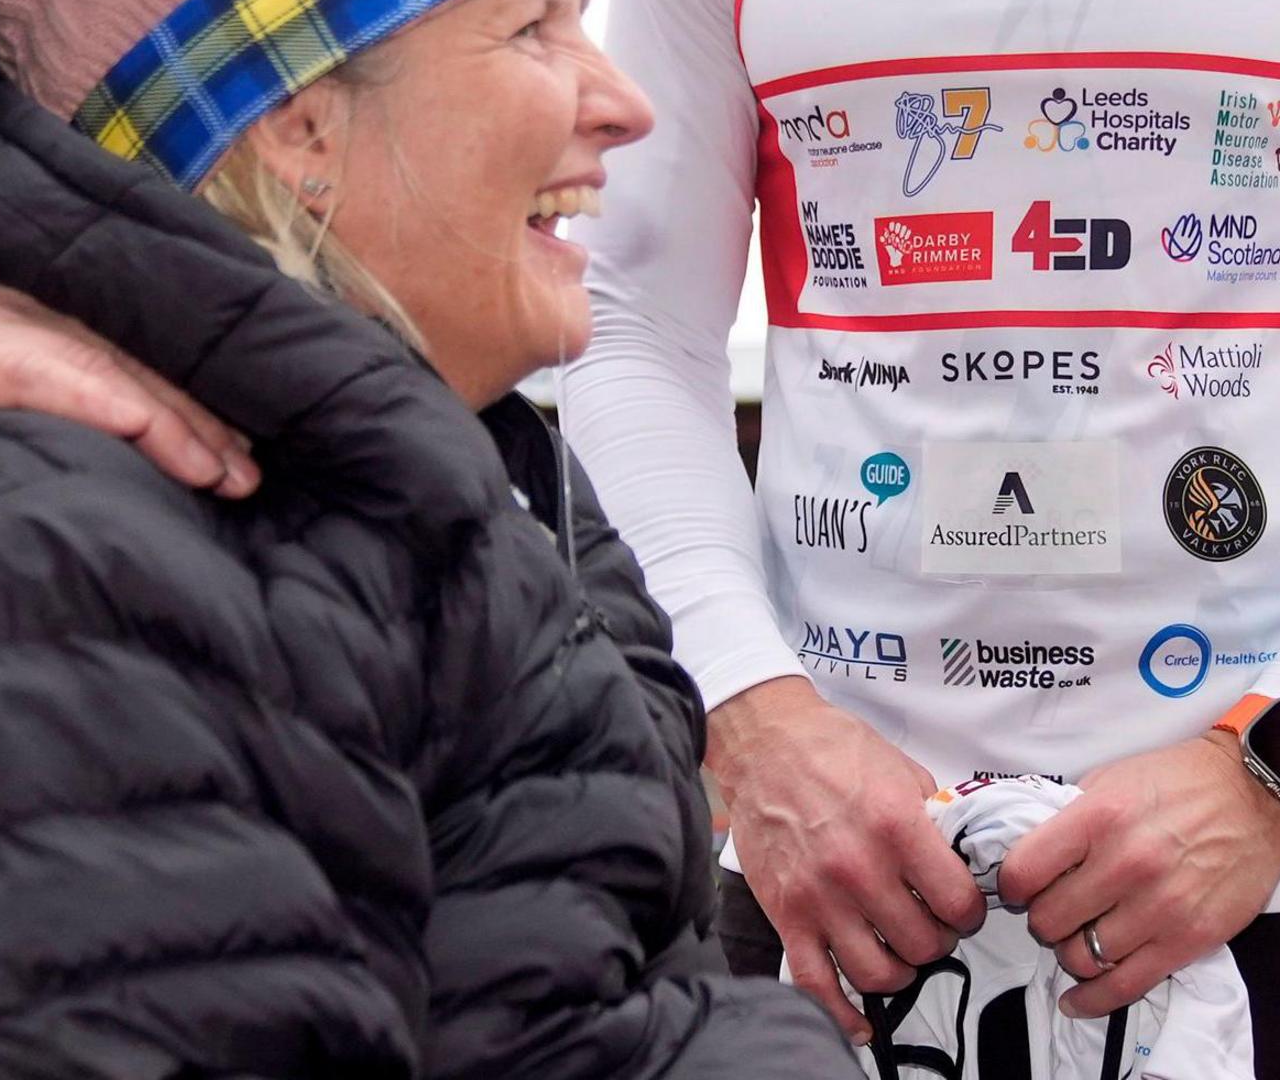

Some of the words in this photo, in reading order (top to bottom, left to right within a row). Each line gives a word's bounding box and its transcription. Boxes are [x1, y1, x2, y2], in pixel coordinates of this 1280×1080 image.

[1082, 88, 1148, 107] Leeds
[1220, 90, 1257, 109] Irish
[941, 87, 991, 160] 7
[1091, 110, 1191, 132] Hospitals
[1217, 110, 1259, 129] Motor
[1096, 131, 1177, 156] Charity
[1215, 129, 1268, 148] Neurone
[1212, 149, 1263, 168] Disease
[1210, 169, 1279, 188] Association
[802, 201, 819, 222] MY
[805, 224, 855, 247] NAME'S
[1012, 200, 1132, 271] 4ED
[1209, 215, 1257, 239] MND
[913, 233, 971, 249] DARBY
[811, 247, 864, 270] DODDIE
[912, 248, 982, 264] RIMMER
[942, 350, 1101, 382] SKOPES
[1179, 343, 1263, 371] Mattioli
[1052, 385, 1074, 394] EST.
[1075, 385, 1099, 394] 1948
[1181, 372, 1251, 398] Woods
[866, 464, 905, 486] GUIDE
[1176, 454, 1207, 481] YORK
[1213, 454, 1246, 480] RLFC
[795, 494, 871, 553] EUAN'S
[930, 524, 1107, 547] AssuredPartners
[1182, 526, 1256, 554] VALKYRIE
[803, 621, 907, 662] MAYO
[977, 640, 1095, 665] business
[1165, 654, 1199, 667] Circle
[1215, 652, 1256, 666] Health
[978, 666, 1055, 689] waste
